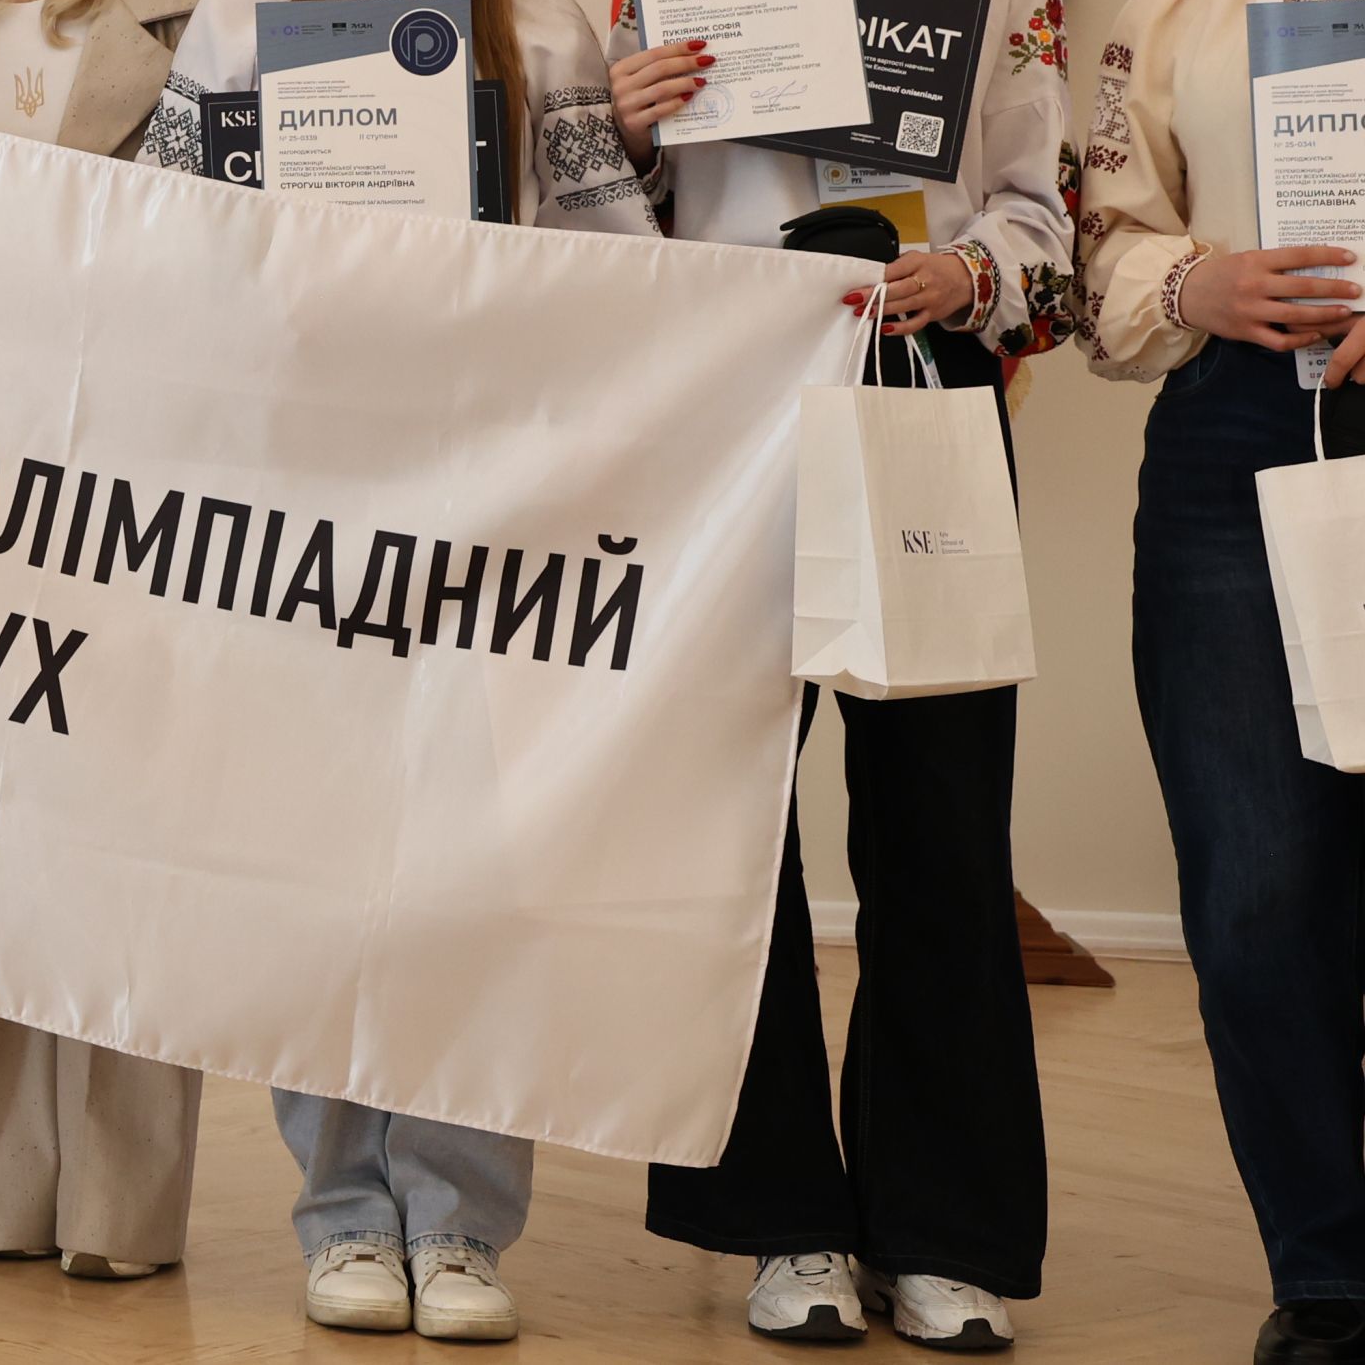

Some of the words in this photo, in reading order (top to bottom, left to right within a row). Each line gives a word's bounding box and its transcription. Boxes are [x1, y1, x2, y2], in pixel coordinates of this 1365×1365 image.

[662, 25, 709, 36] ЛУКІЯНЮК
[712, 21, 740, 31] СОФІЯ
[900, 88, 942, 100] олімпіади
[221, 110, 257, 127] KSE
[279, 108, 396, 130] ДИПЛОМ
[1274, 113, 1365, 136] ДИПЛО
[325, 180, 364, 188] ВІКТОРІЯ
[367, 179, 414, 188] АНДРІЇВНА
[1276, 189, 1335, 197] ВОЛОШИНА
[1276, 198, 1355, 207] СТАНІСЛАВІВНА
[901, 530, 933, 554] KSE
